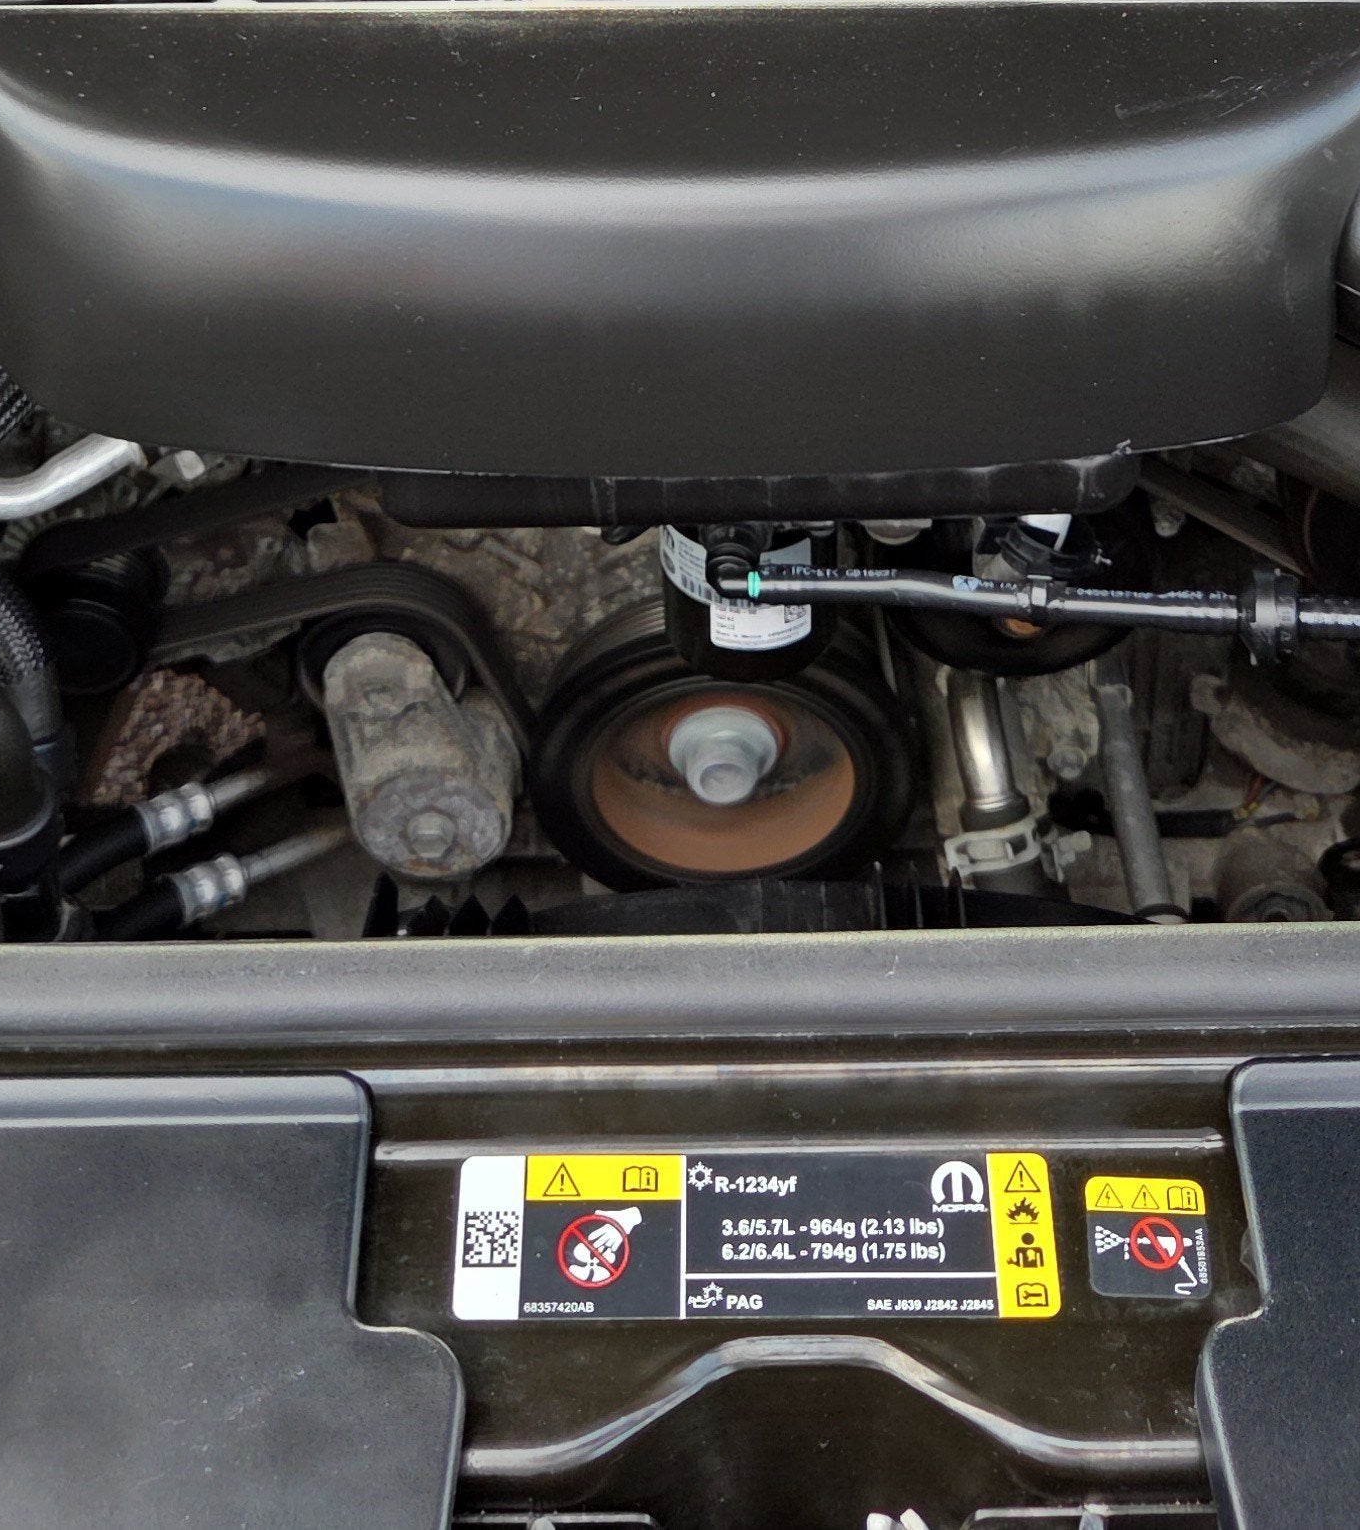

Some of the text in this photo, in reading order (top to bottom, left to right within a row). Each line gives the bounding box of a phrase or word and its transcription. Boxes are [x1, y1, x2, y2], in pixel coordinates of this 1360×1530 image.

[714, 1175, 798, 1197] R-1234yf
[721, 1218, 796, 1237] 3.6/5.7L
[809, 1218, 857, 1239] 964g
[860, 1217, 906, 1239] (2.13
[909, 1217, 946, 1239] lbs)
[721, 1242, 797, 1261] 6.2/6.4L
[810, 1242, 857, 1263] 794g
[861, 1241, 907, 1263] (1.75
[910, 1241, 947, 1263] lbs)
[523, 1301, 596, 1313] 68357420AB
[726, 1294, 764, 1310] PAG
[867, 1299, 893, 1311] SAE
[894, 1299, 922, 1312] J639
